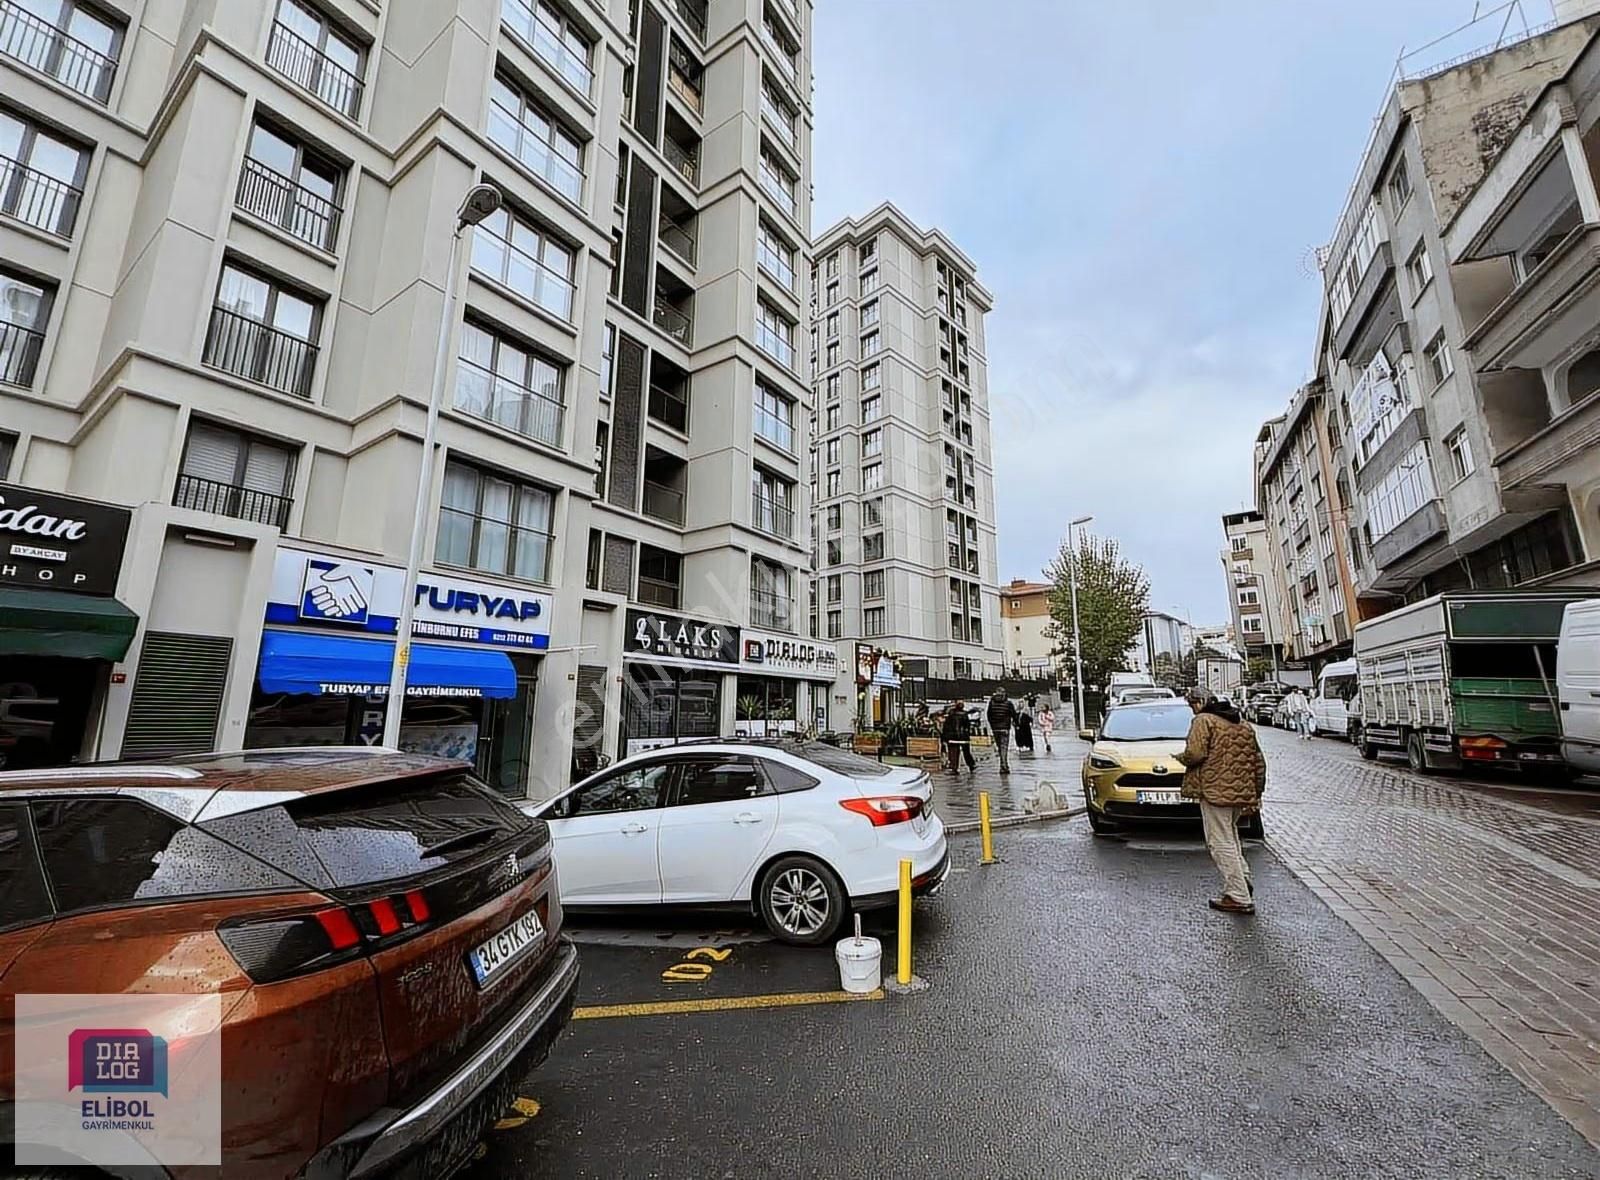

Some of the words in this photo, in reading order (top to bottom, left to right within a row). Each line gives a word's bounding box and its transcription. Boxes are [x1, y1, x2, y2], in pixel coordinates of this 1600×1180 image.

[0, 496, 86, 540] dan
[414, 584, 541, 622] TURYAP
[395, 619, 459, 637] TİNBURNU
[459, 628, 480, 640] EFES
[657, 620, 721, 649] LAKS
[320, 683, 371, 694] TURYAP
[374, 685, 391, 695] EF
[406, 685, 483, 697] GAYRİMENKUL
[478, 941, 500, 972] 34
[498, 924, 524, 958] GTK
[522, 912, 543, 940] 192
